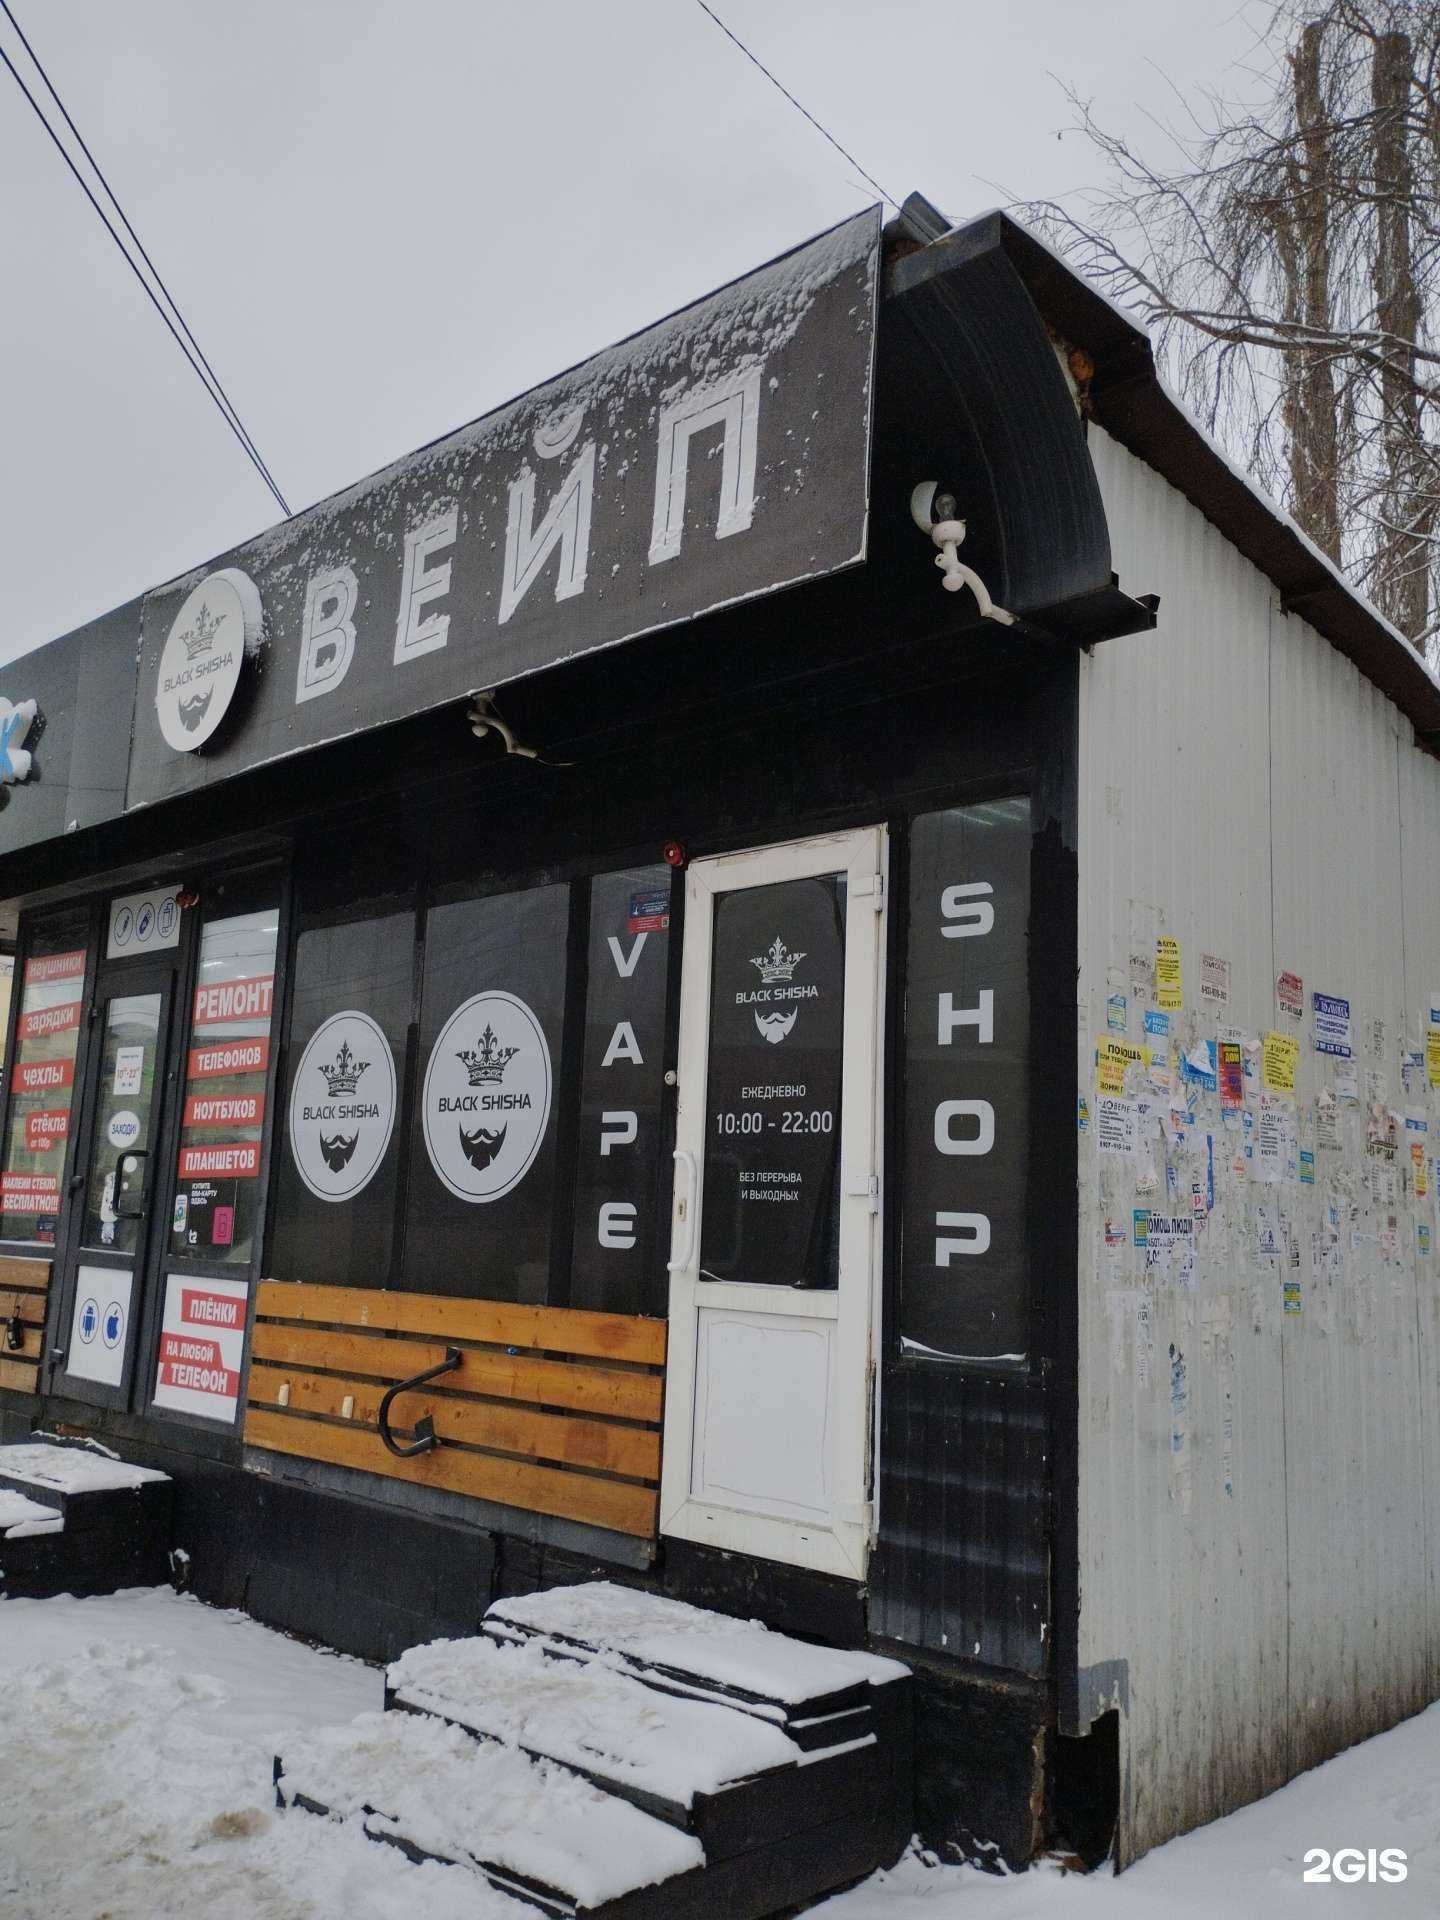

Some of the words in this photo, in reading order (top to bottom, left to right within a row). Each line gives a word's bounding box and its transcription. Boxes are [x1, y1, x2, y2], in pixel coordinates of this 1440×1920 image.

[296, 364, 765, 704] ВЕЙП
[163, 667, 193, 692] BLACK
[195, 651, 233, 678] SHISHA
[30, 955, 82, 976] наушники
[196, 980, 274, 1019] РЕМОНТ
[735, 989, 771, 1004] BLACK
[774, 985, 818, 1000] SHISHA
[26, 1010, 74, 1034] зарядки
[198, 1046, 261, 1070] ТЕЛЕФОНОВ
[23, 1065, 64, 1086] чехлы
[934, 881, 995, 1267] SHOP
[598, 932, 648, 1249] VAPE
[741, 1084, 806, 1099] ЕЖЕДНЕВНО
[193, 1099, 256, 1120] НОУТБУКОВ
[303, 1104, 335, 1120] BLACK
[338, 1103, 380, 1119] SHISHA
[438, 1096, 478, 1112] BLACK
[481, 1093, 531, 1111] SHISHA
[31, 1113, 66, 1133] стёкла
[716, 1112, 762, 1134] 10:00
[781, 1110, 833, 1133] 22:00
[185, 1150, 255, 1170] ПЛАНШЕТОВ
[739, 1172, 755, 1183] БЕЗ
[757, 1172, 802, 1183] ПЕРЕРЫВА
[741, 1190, 747, 1200] И
[750, 1190, 799, 1202] ВЫХОДНЫХ
[190, 1297, 237, 1323] ПЛЁНКИ
[166, 1340, 179, 1356] НА
[179, 1341, 215, 1364] ЛЮБОЙ
[171, 1363, 228, 1393] ТЕЛЕФОН
